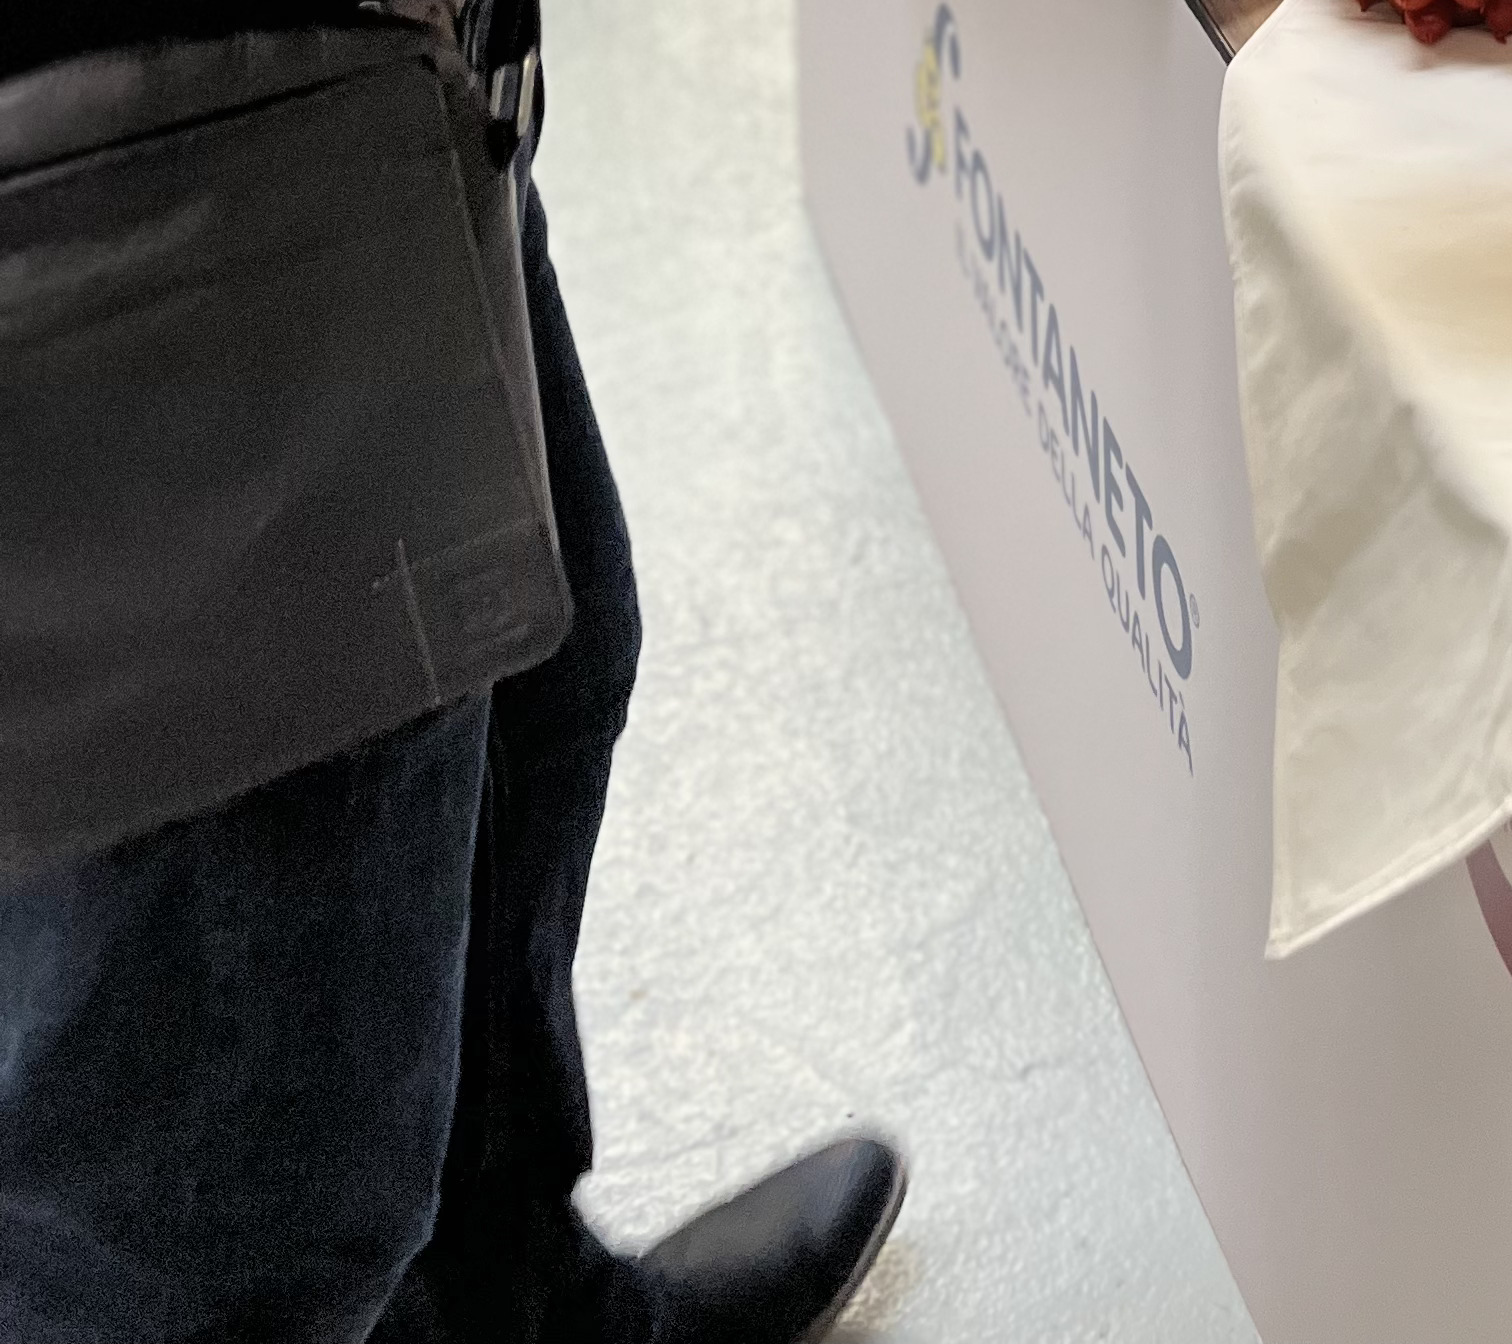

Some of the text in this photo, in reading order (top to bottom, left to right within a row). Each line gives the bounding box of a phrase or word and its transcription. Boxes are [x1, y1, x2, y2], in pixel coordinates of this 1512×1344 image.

[953, 106, 1194, 681] FONTANETO
[1036, 400, 1095, 561] DELLA
[1101, 543, 1194, 779] QUALITÀ
